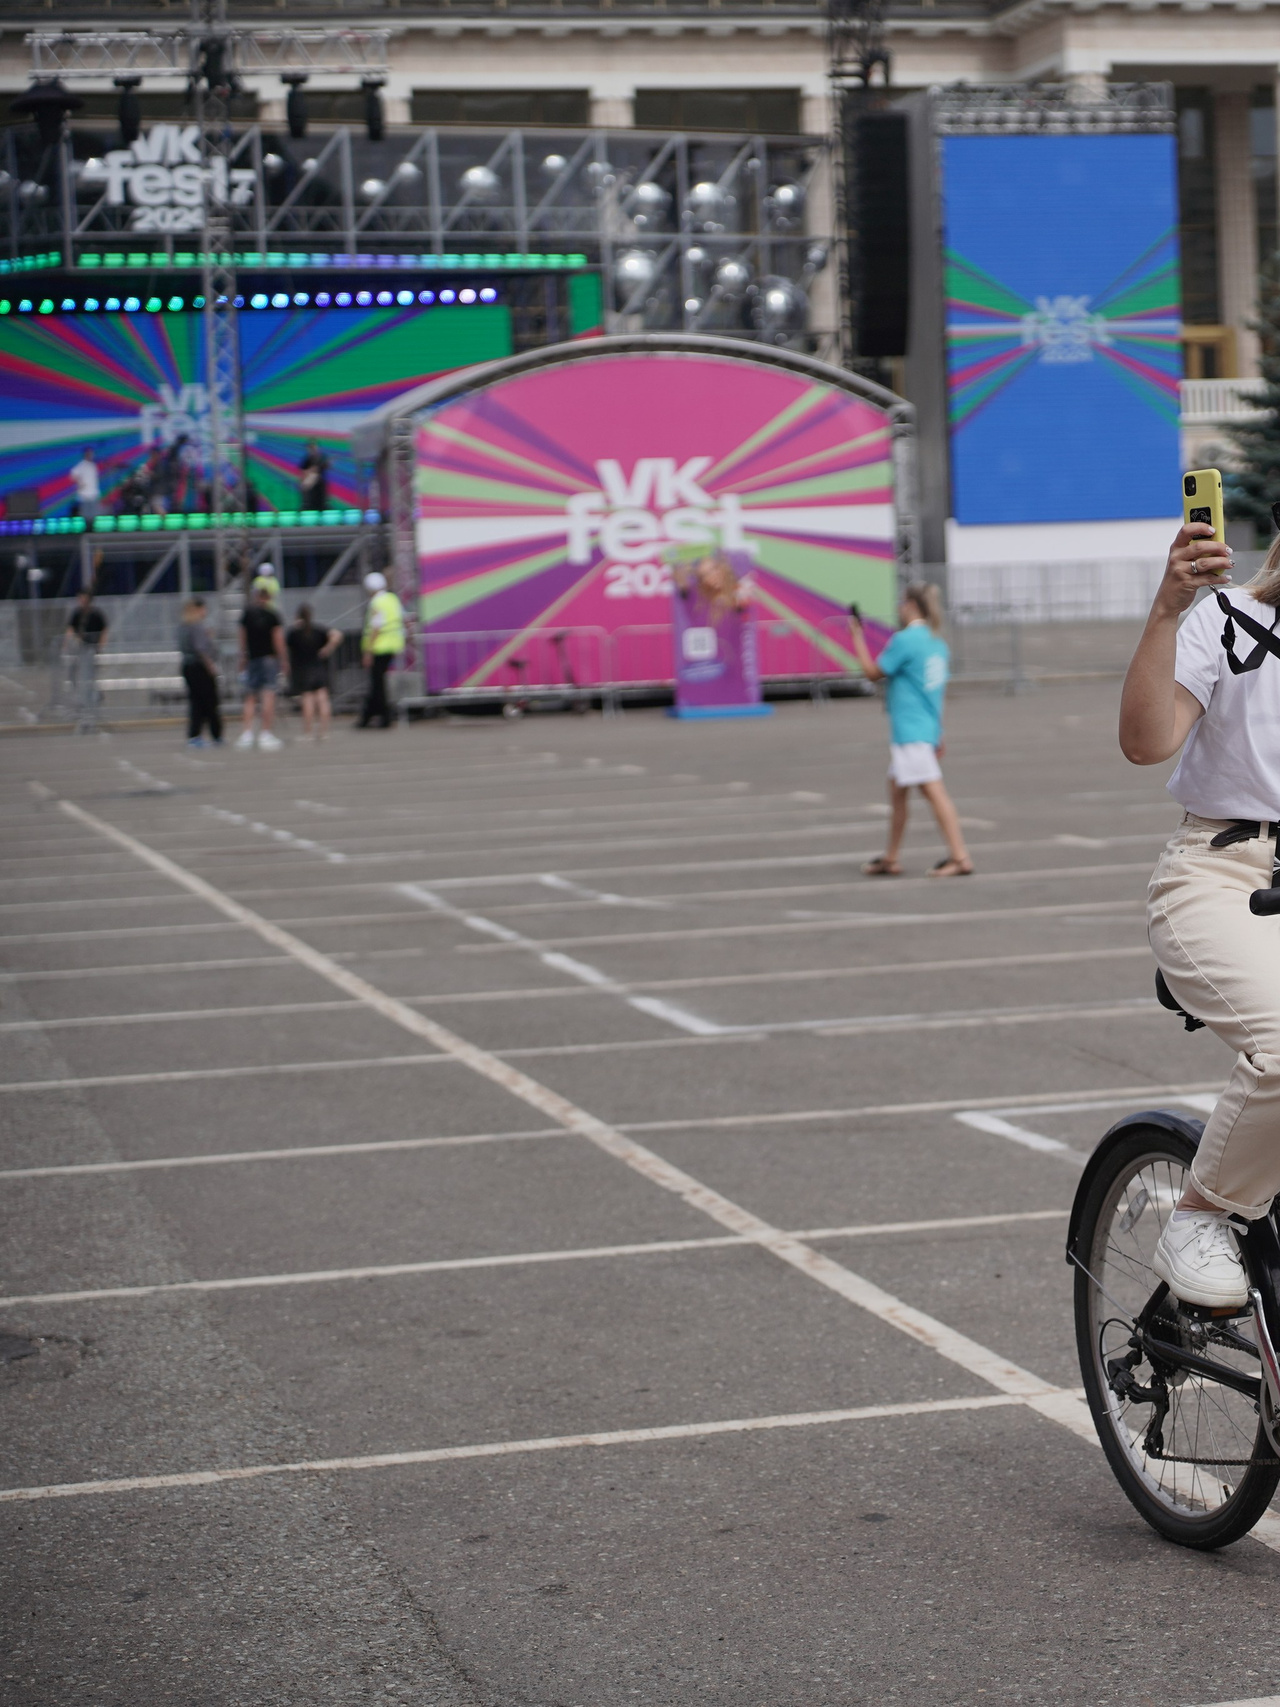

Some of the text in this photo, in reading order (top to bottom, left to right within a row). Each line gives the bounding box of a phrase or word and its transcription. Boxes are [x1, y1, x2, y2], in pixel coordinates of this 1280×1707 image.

[131, 123, 202, 163] VK
[596, 457, 714, 507] VK
[565, 491, 760, 566] fest
[603, 563, 674, 598] 202
